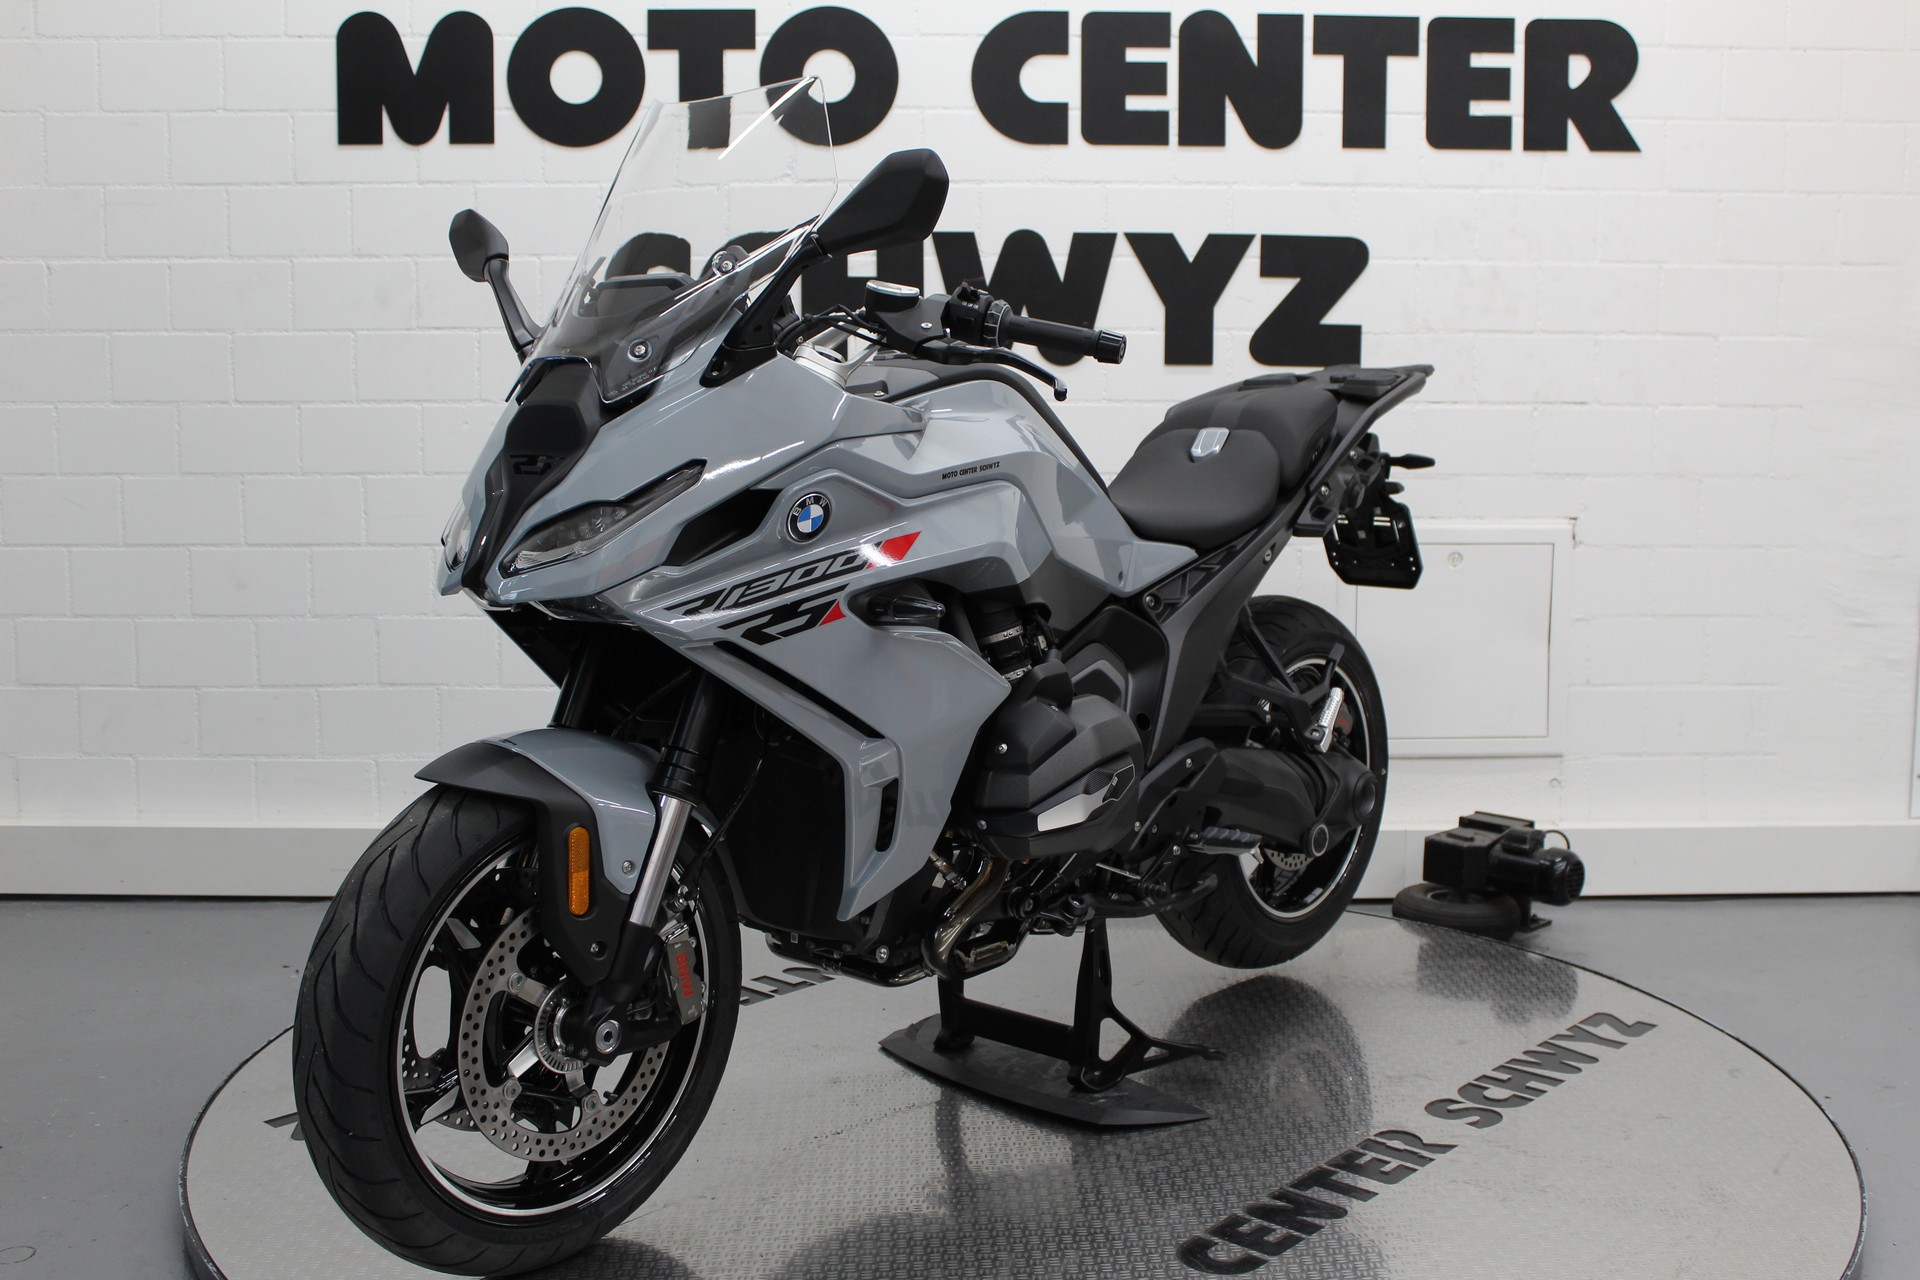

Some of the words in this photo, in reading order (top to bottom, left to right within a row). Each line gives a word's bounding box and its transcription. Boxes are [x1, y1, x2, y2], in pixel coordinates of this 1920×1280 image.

[337, 7, 898, 149] MOTO
[971, 10, 1641, 153] CENTER
[941, 470, 958, 480] MOTO
[959, 466, 978, 476] CENTER
[792, 495, 829, 517] BMW
[717, 583, 848, 646] RS
[675, 951, 696, 998] BMW
[1176, 1129, 1459, 1276] CENTER
[1424, 1012, 1658, 1130] SCHWYZ
